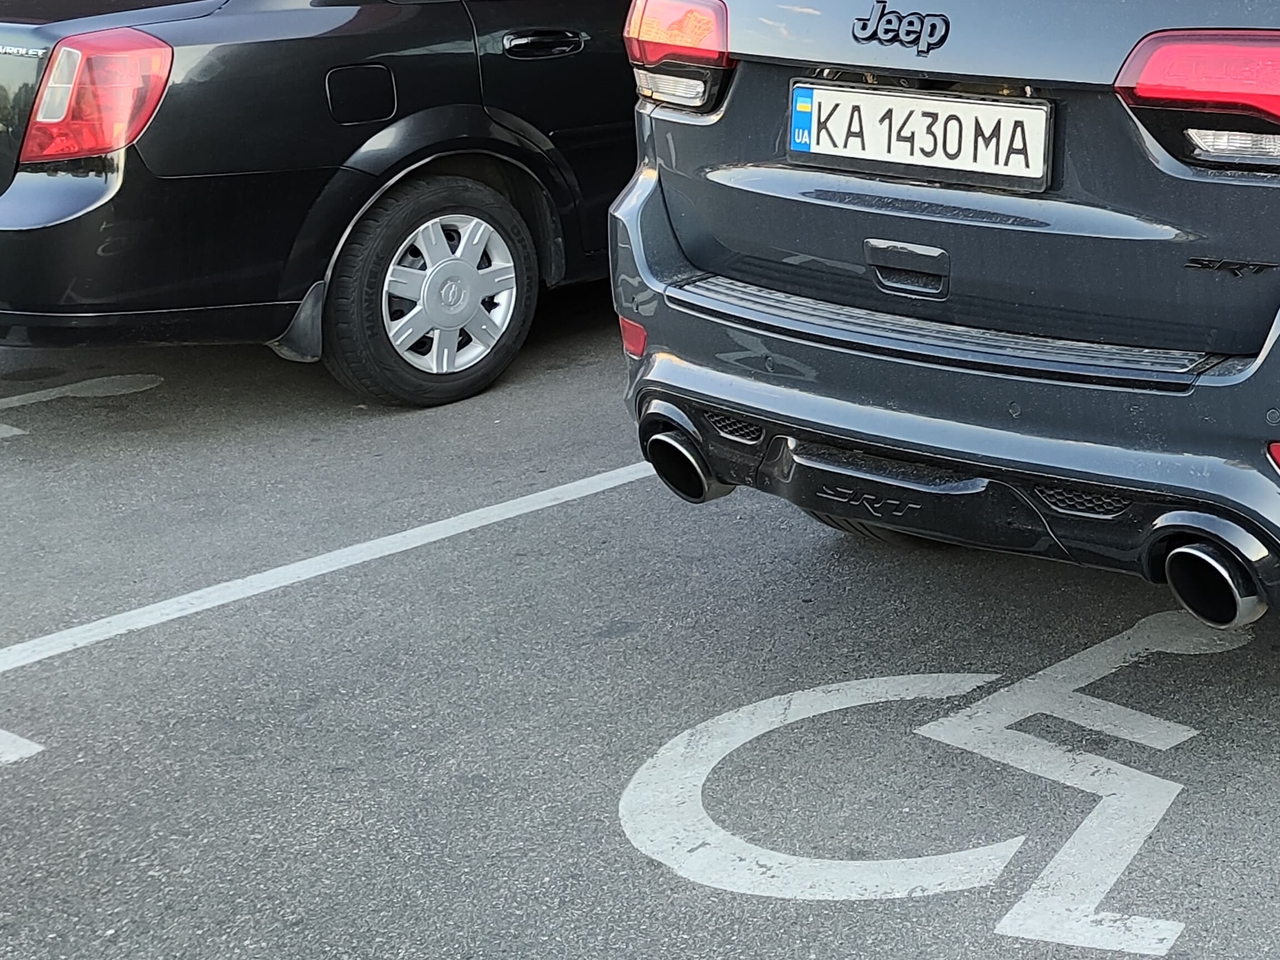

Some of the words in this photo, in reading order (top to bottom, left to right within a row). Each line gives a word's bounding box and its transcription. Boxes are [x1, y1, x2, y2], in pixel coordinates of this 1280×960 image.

[852, 0, 950, 57] Jeep
[794, 128, 810, 145] UA
[816, 101, 866, 151] KA
[878, 107, 963, 161] 1430
[972, 115, 1031, 170] MA
[816, 486, 922, 517] SRT
